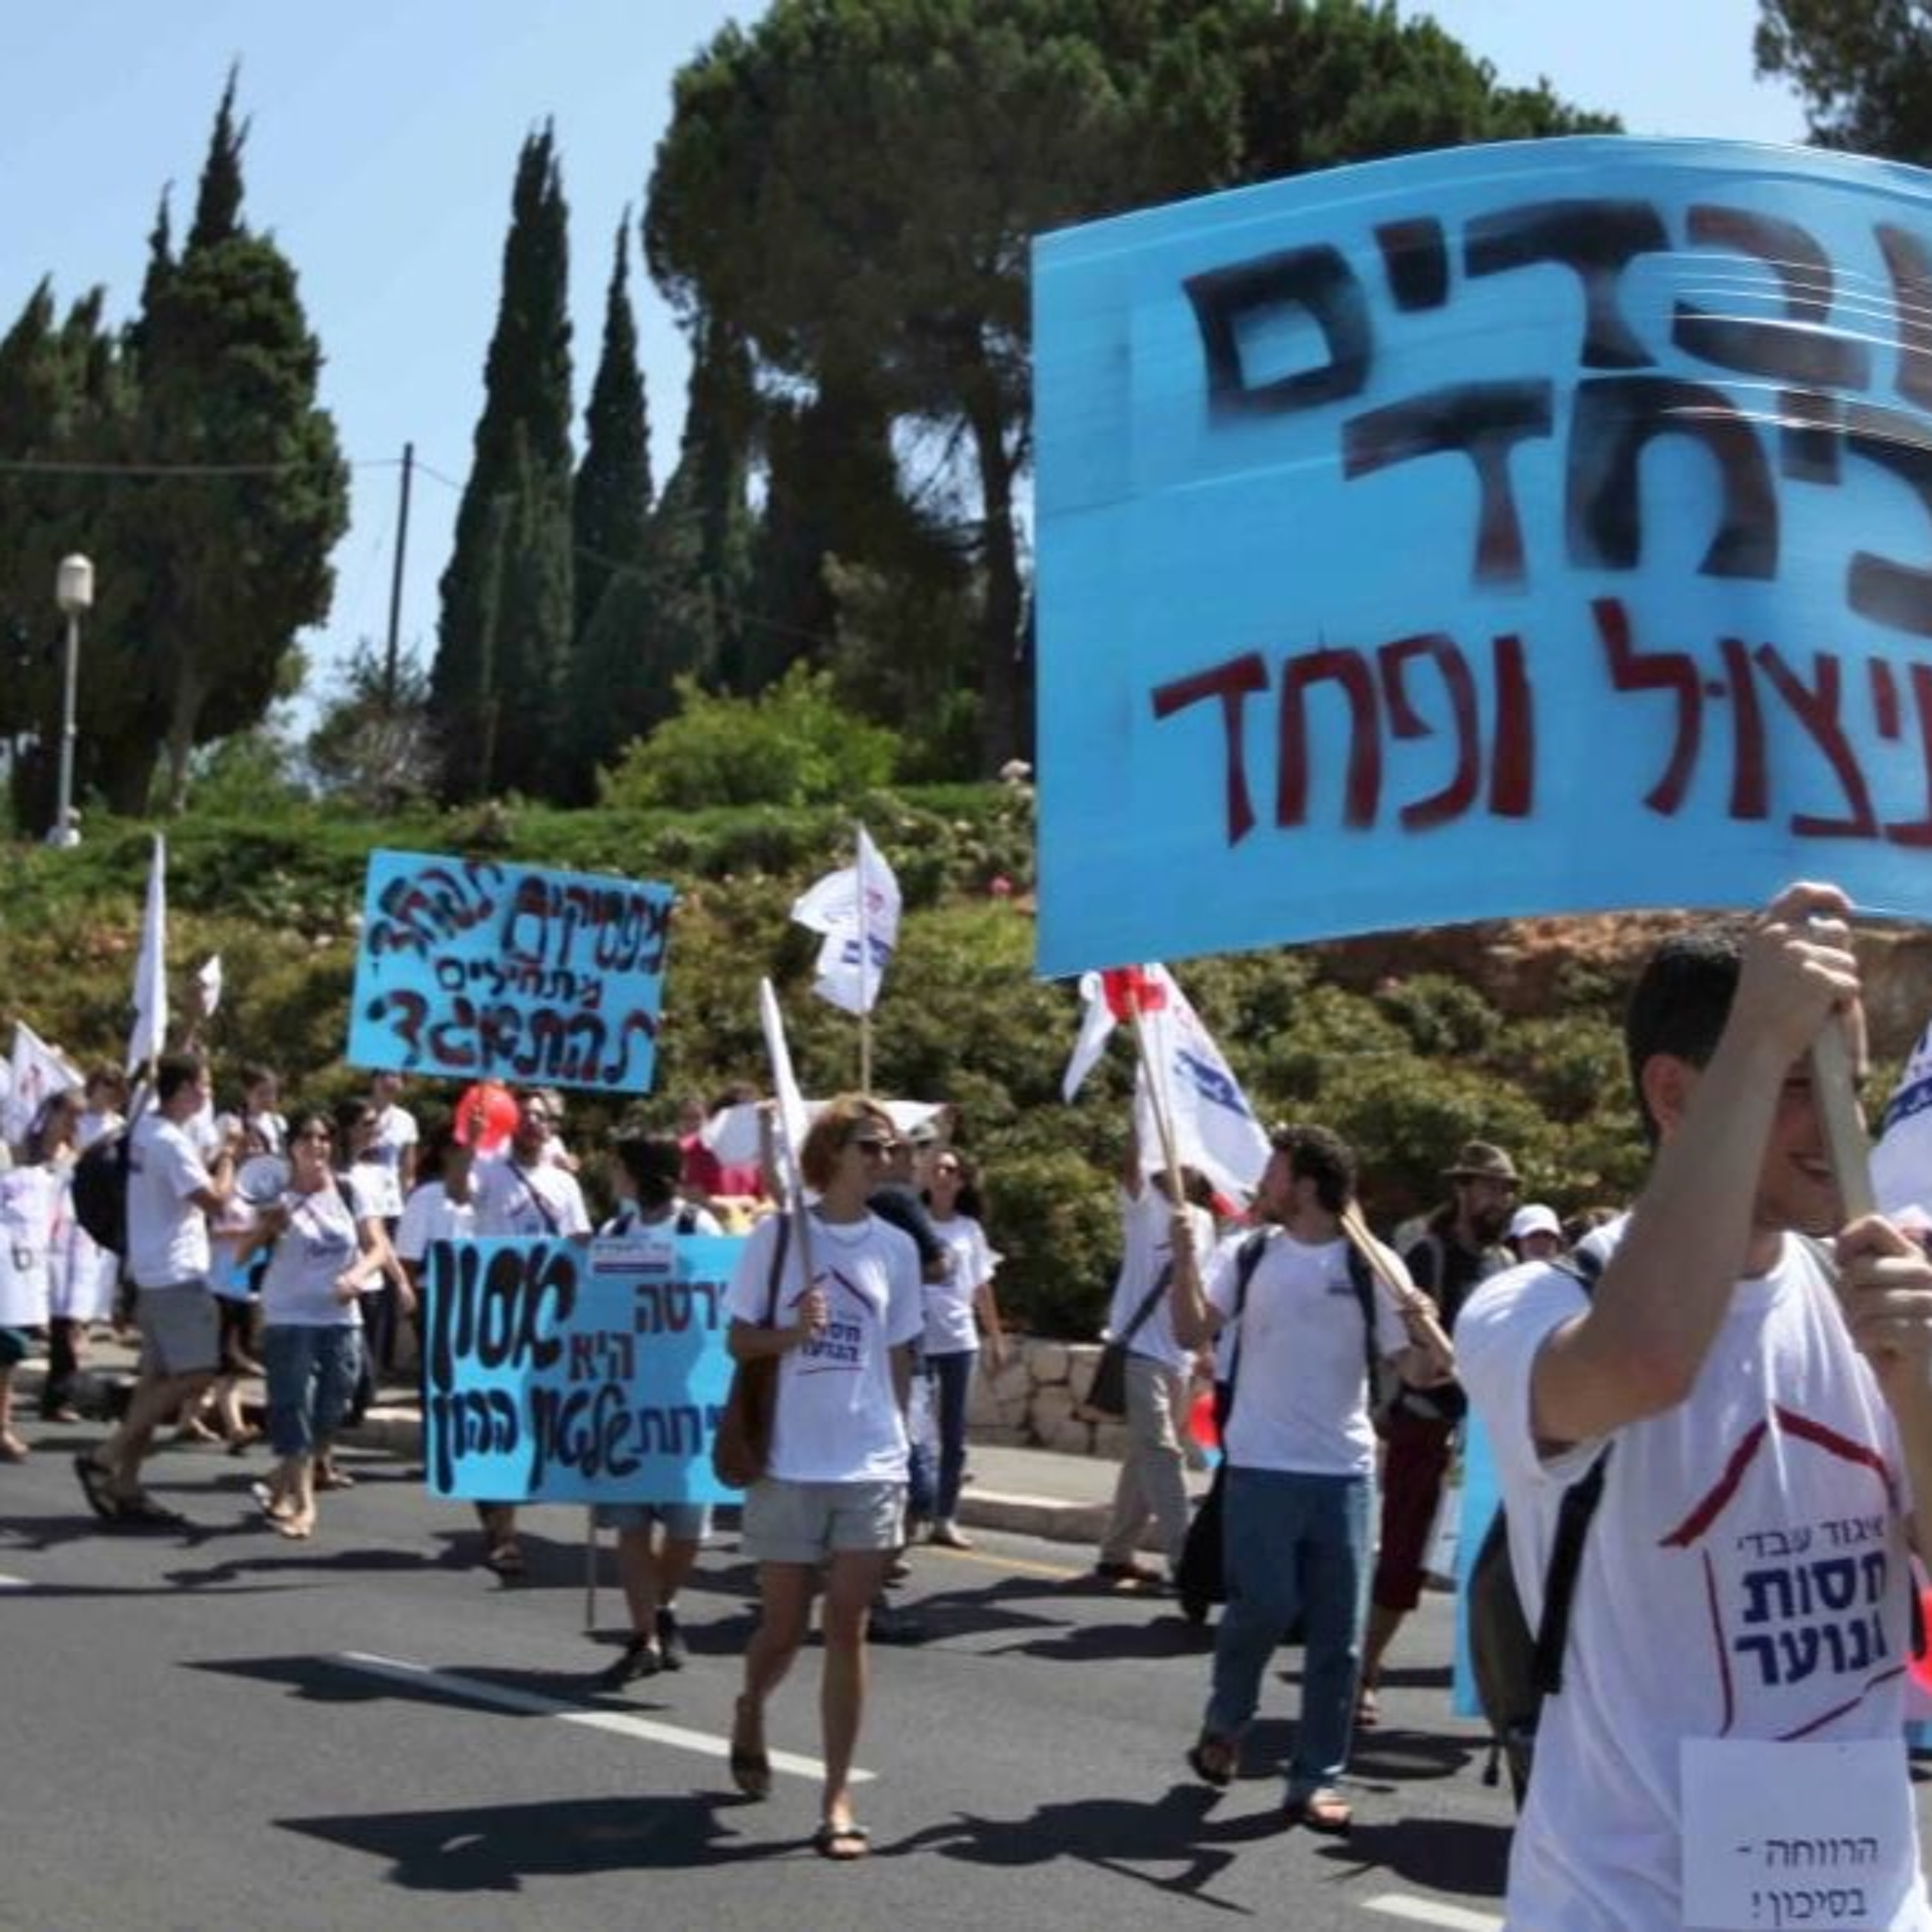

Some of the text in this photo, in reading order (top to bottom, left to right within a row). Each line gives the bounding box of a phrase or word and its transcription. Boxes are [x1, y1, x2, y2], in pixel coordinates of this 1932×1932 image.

[1152, 634, 1535, 849] ופחד
[432, 1239, 635, 1391] היא אסון
[635, 1280, 727, 1334] רטה
[1741, 1549, 1887, 1624] חסות
[1734, 1609, 1888, 1686] ונוער
[1765, 1837, 1878, 1867] הרווחה
